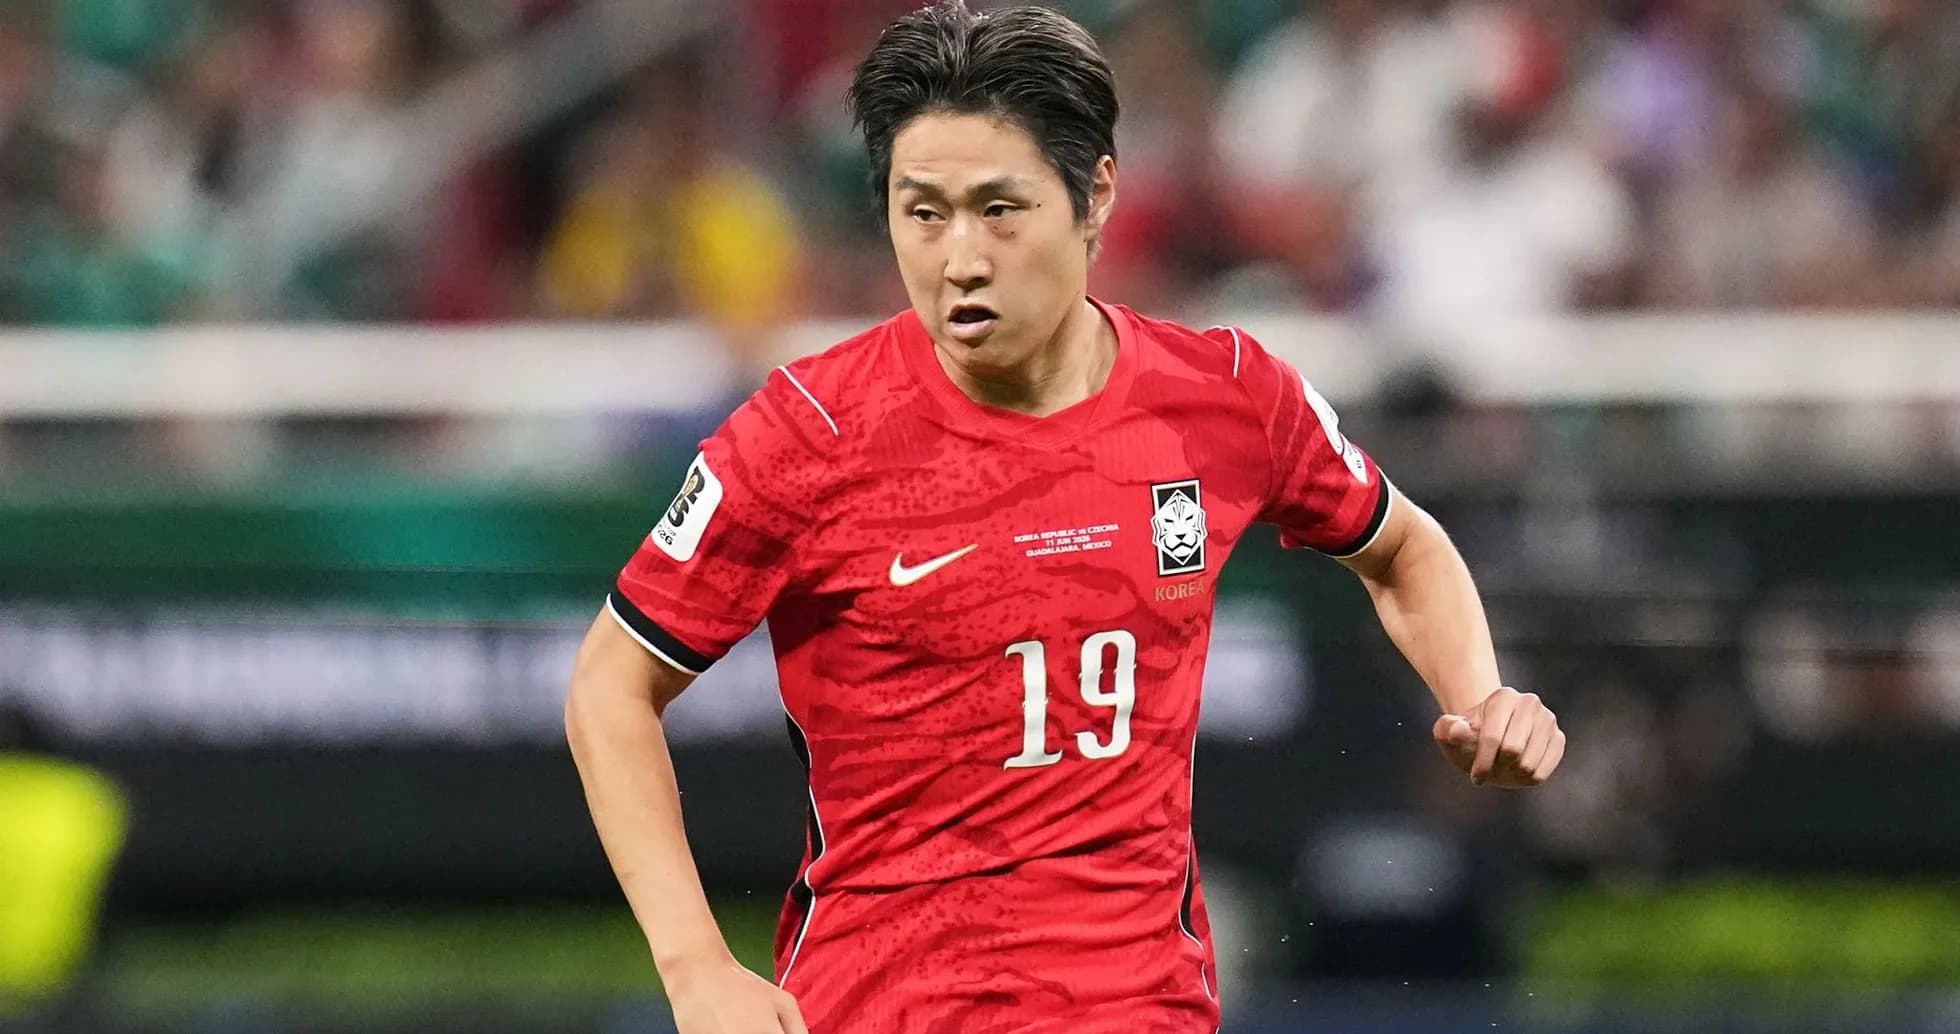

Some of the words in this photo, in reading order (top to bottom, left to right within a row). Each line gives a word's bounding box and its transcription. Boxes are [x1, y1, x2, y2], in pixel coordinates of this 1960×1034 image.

[1014, 533, 1040, 543] KOREA
[1040, 529, 1077, 539] REPUBLIC
[1087, 524, 1119, 534] CZECHIA
[1056, 538, 1071, 546] JUN
[1072, 535, 1091, 543] 2026
[1025, 545, 1081, 557] GUADALAJARA,
[1082, 540, 1112, 550] MEXICO
[1154, 580, 1205, 602] KOREA
[1003, 629, 1137, 771] 19
